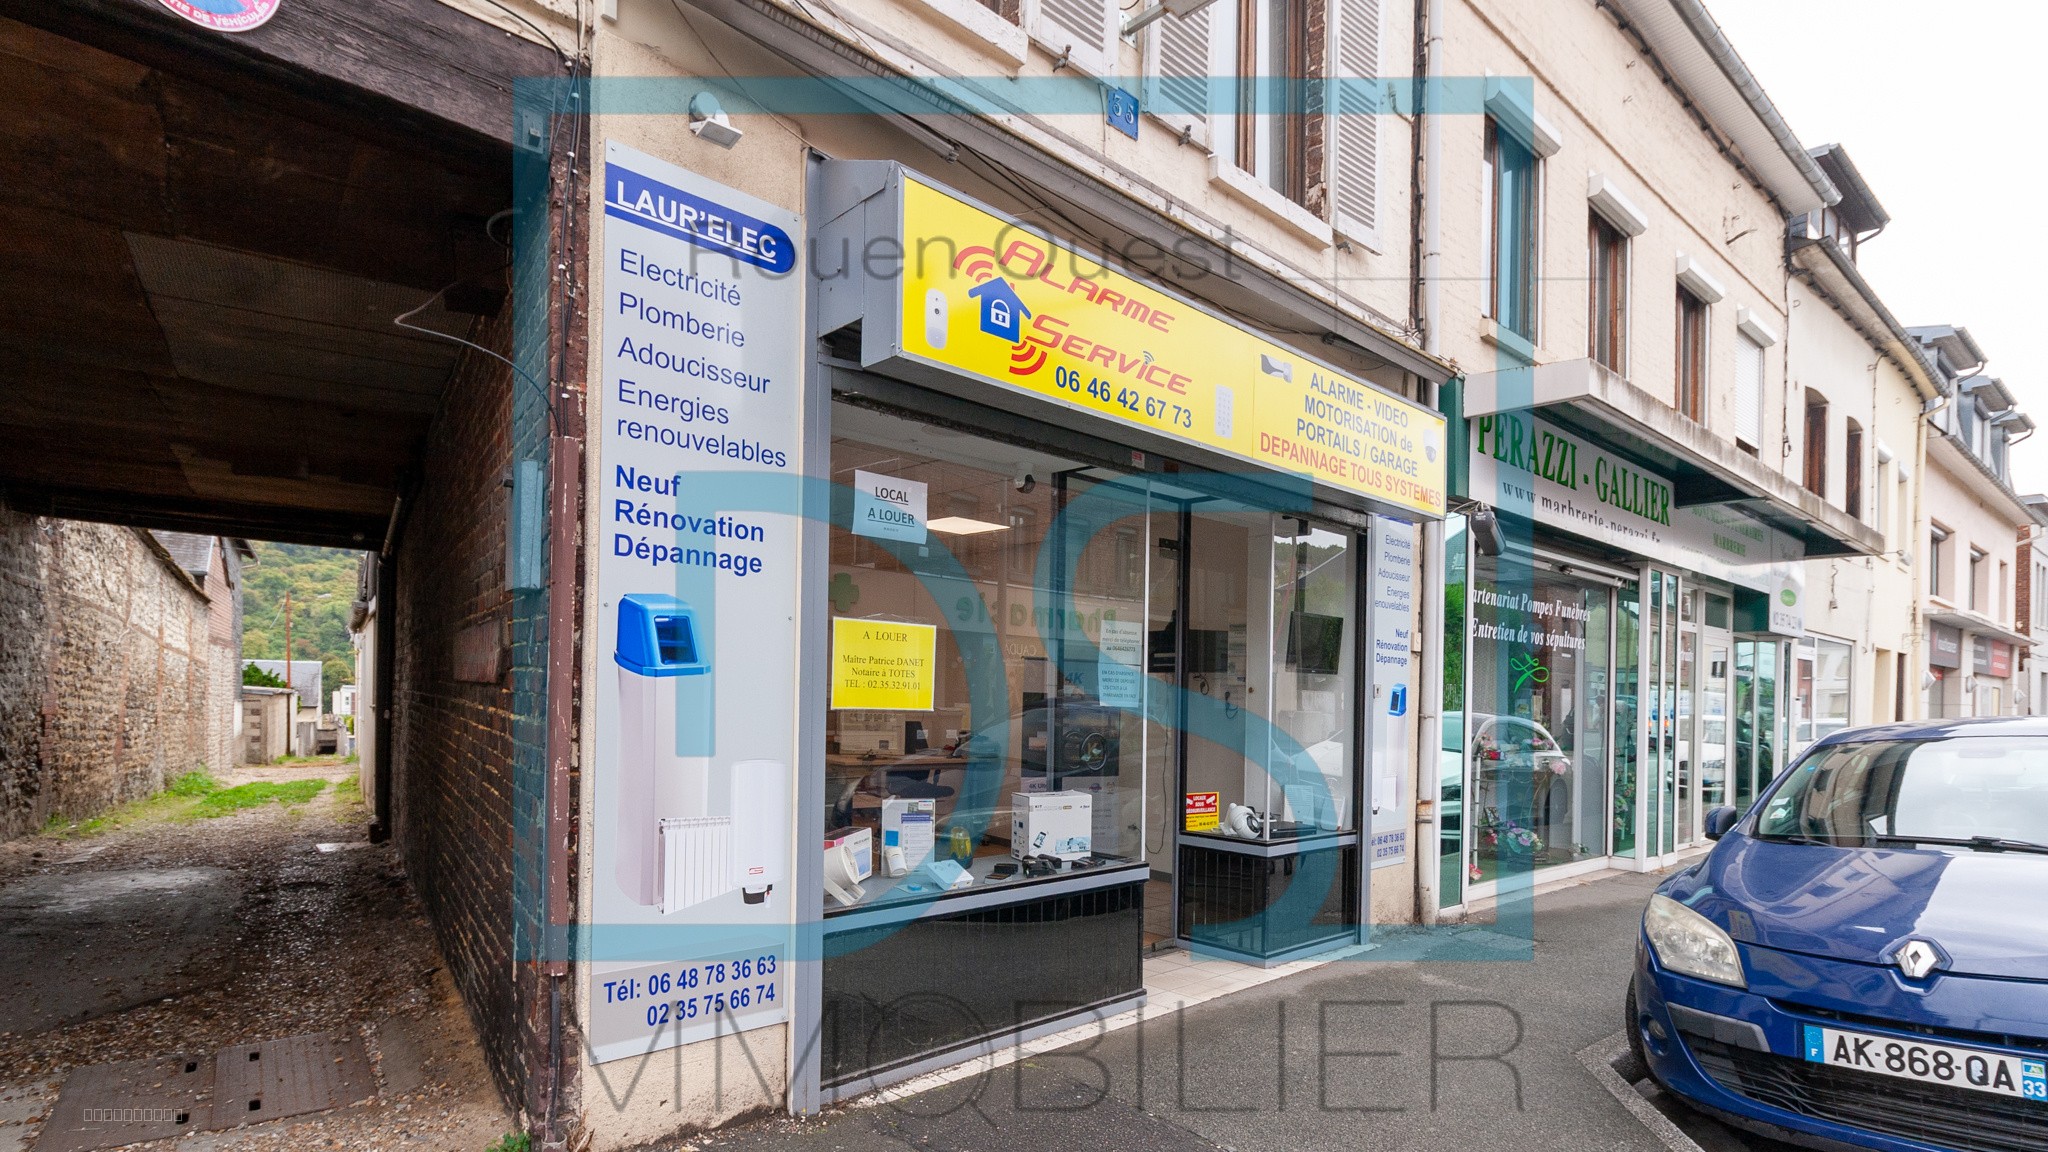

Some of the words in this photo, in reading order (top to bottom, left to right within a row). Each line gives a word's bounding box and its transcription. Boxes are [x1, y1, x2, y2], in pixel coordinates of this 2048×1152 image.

[617, 180, 777, 259] LAUR'ELEC
[620, 248, 742, 306] Electricité
[998, 240, 1176, 334] ALARME
[619, 291, 746, 348] Plomberie
[617, 336, 771, 394] Adoucisseur
[1025, 314, 1193, 396] SERVICE
[618, 379, 730, 425] Energies
[1055, 366, 1080, 392] 06
[1087, 377, 1111, 402] 46
[1117, 386, 1139, 412] 42
[1145, 396, 1167, 420] 67
[1172, 405, 1193, 428] 73
[1310, 372, 1364, 411] ALARME
[1374, 399, 1409, 428] VIDEO
[617, 418, 787, 468] renouvelables
[1304, 395, 1398, 445] MOTORISATION
[1400, 435, 1413, 453] de
[1260, 432, 1347, 478] DEPANNAGE
[1350, 462, 1382, 489] TOUS
[1385, 475, 1441, 508] SYSTEMES
[1296, 418, 1361, 457] PORTAILS
[1370, 446, 1419, 478] GARAGE
[1477, 411, 1578, 491] PERAZZI
[1595, 456, 1671, 527] GALLIER
[615, 464, 682, 497] Neuf
[875, 486, 909, 503] LOCAL
[614, 498, 765, 542] Rénovation
[867, 507, 876, 519] A
[879, 509, 915, 525] LOUER
[613, 533, 763, 577] Dépannage
[1378, 567, 1411, 583] Adoucisseur
[1384, 551, 1411, 566] Plomberie
[1375, 600, 1410, 613] enouvelables
[1386, 585, 1410, 600] Energies
[1472, 589, 1519, 610] artenariat
[1521, 593, 1553, 619] Pompes
[1555, 599, 1591, 622] Funèbres
[863, 631, 870, 640] A
[875, 631, 908, 642] LOUER
[1376, 638, 1408, 652] Rénovation
[1395, 628, 1409, 639] Neuf
[1472, 617, 1515, 642] Entretien
[1517, 624, 1528, 643] de
[1530, 631, 1545, 646] vos
[1546, 629, 1586, 651] sépultures
[842, 655, 866, 664] Maître
[868, 656, 895, 665] Patrice
[896, 657, 924, 667] DANET
[851, 668, 880, 677] Notaire
[888, 669, 915, 678] TOTES
[1376, 652, 1408, 667] Dépannage
[845, 679, 860, 688] TEL
[603, 978, 641, 1003] Tél:
[648, 973, 671, 996] 06
[676, 968, 698, 990] 48
[705, 963, 726, 985] 78
[731, 959, 752, 981] 36
[757, 954, 776, 976] 63
[647, 1003, 669, 1027] 02
[676, 997, 697, 1021] 35
[704, 993, 725, 1015] 75
[730, 987, 750, 1010] 66
[756, 983, 775, 1004] 74
[1810, 1048, 1818, 1057] F
[1833, 1035, 2016, 1092] AK-868-QA
[2023, 1080, 2047, 1098] 33
